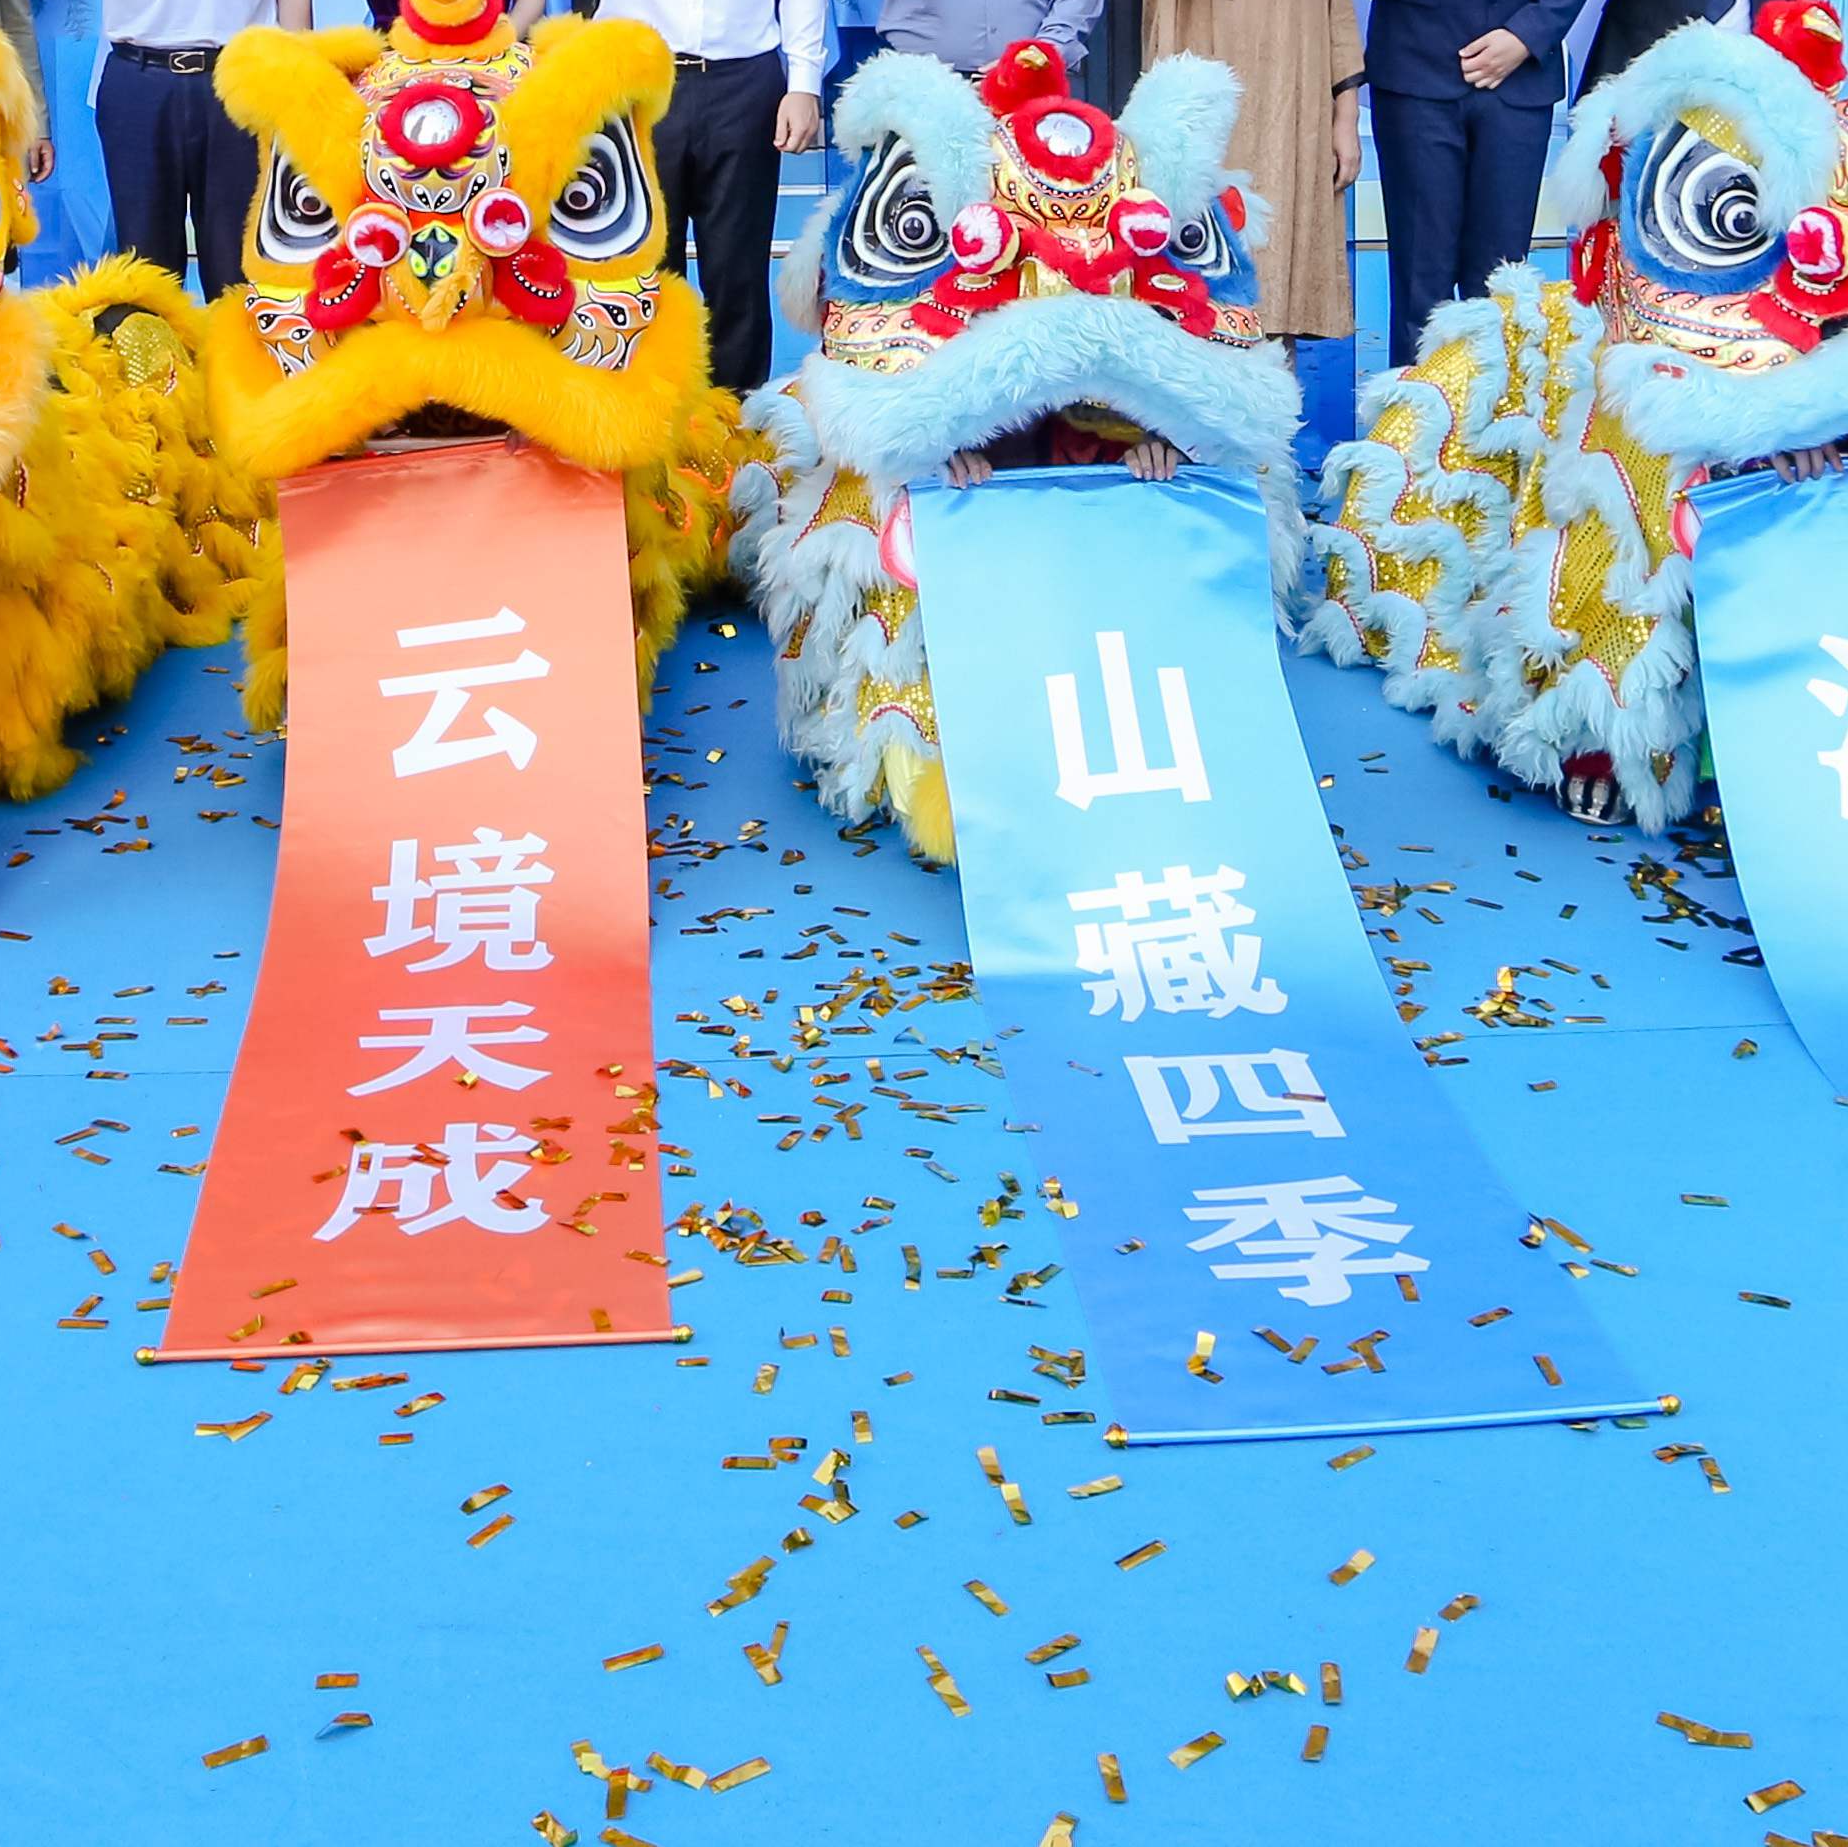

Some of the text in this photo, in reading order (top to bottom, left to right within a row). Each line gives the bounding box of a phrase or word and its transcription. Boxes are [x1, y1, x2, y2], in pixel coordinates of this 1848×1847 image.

[312, 607, 556, 1243] 云境天成
[1044, 630, 1431, 1308] 山藏四季
